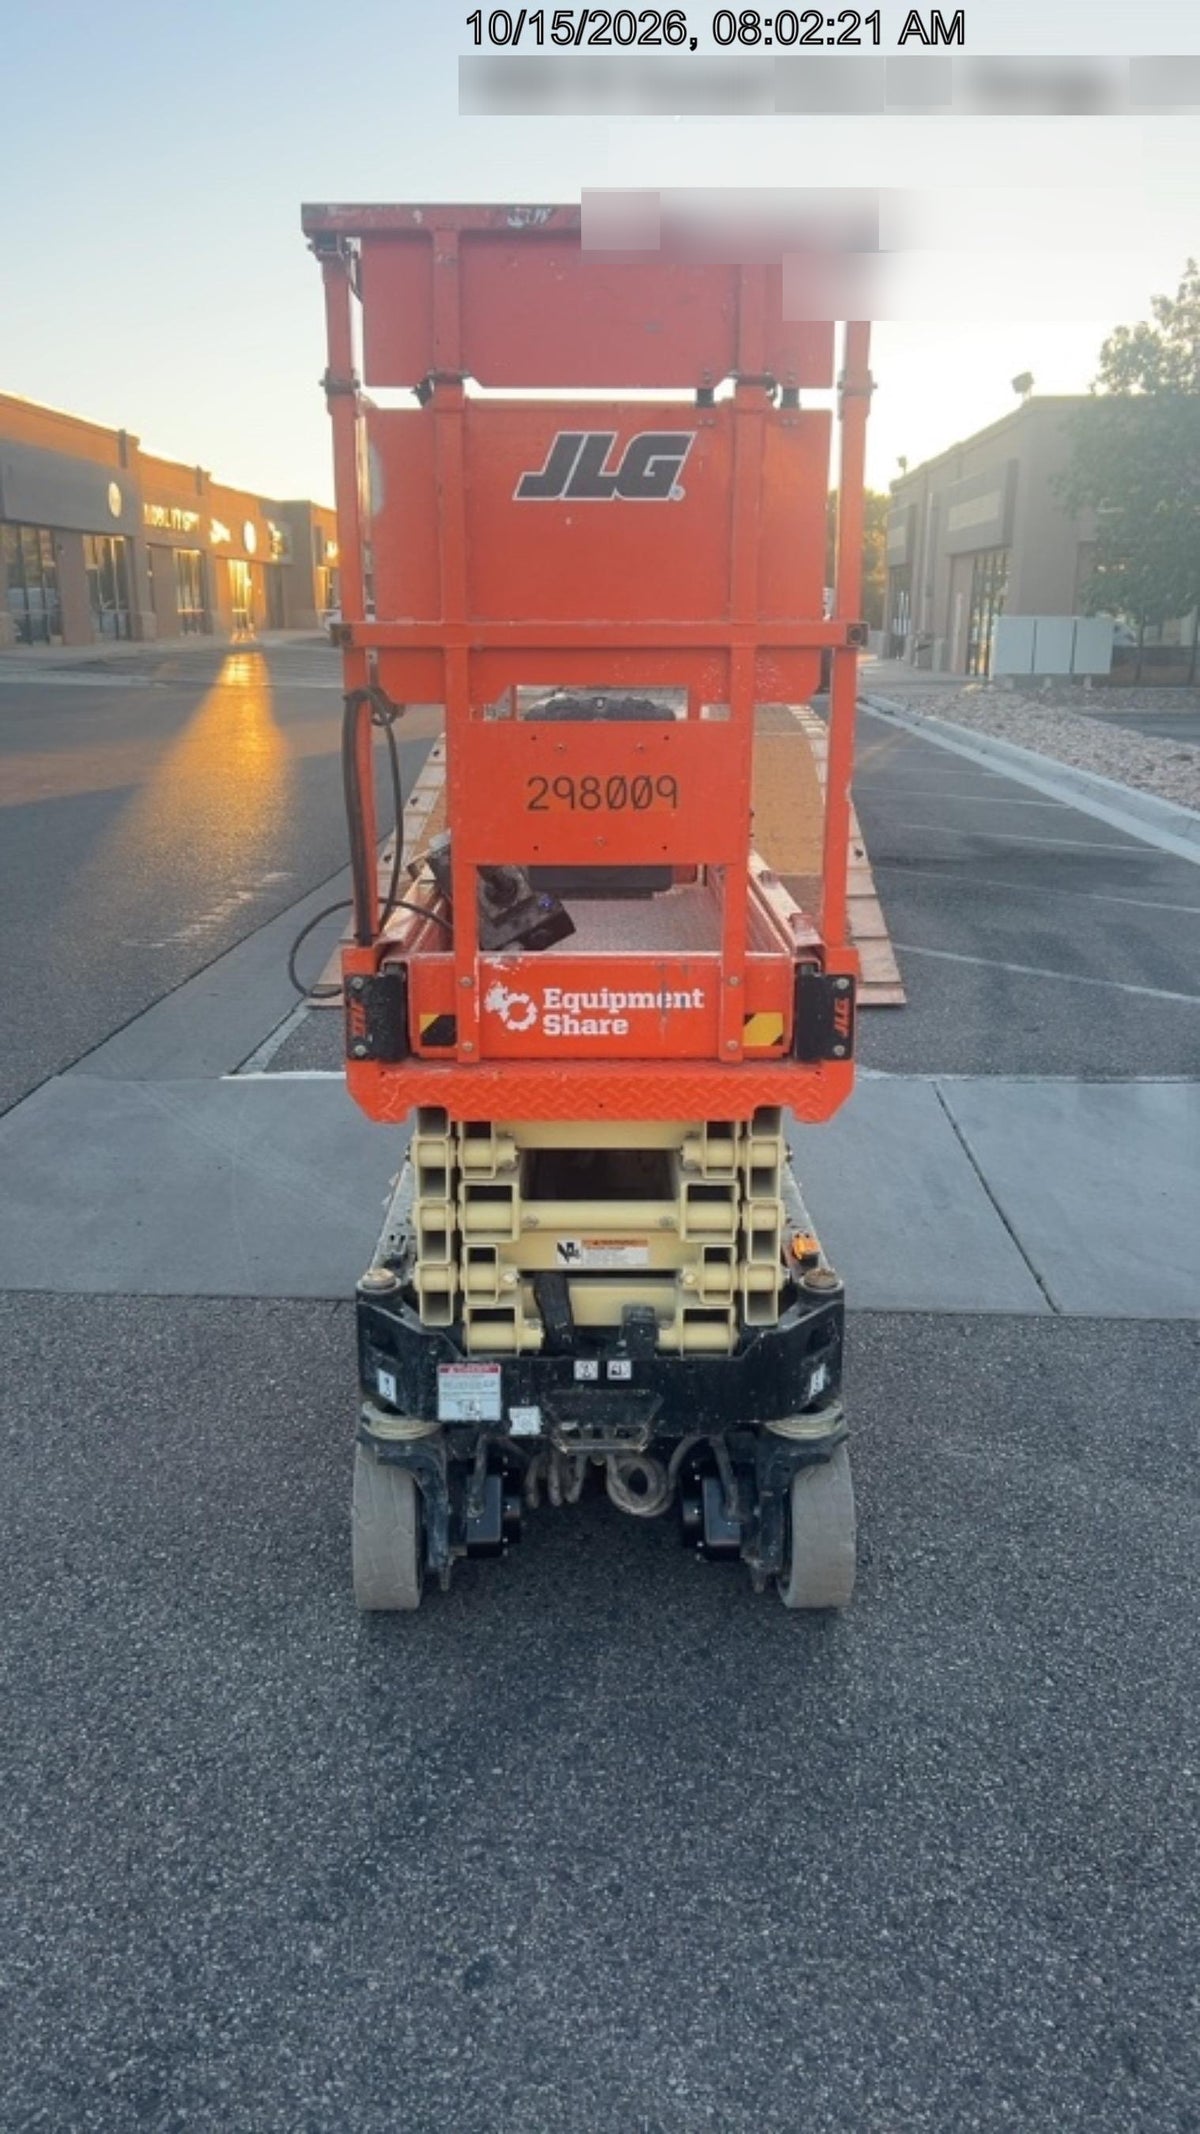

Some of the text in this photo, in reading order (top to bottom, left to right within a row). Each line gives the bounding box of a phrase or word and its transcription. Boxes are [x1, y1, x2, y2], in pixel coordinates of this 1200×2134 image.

[512, 431, 698, 501] JLG
[526, 774, 679, 811] 298009
[542, 988, 705, 1015] Equipment
[542, 1014, 629, 1036] Share
